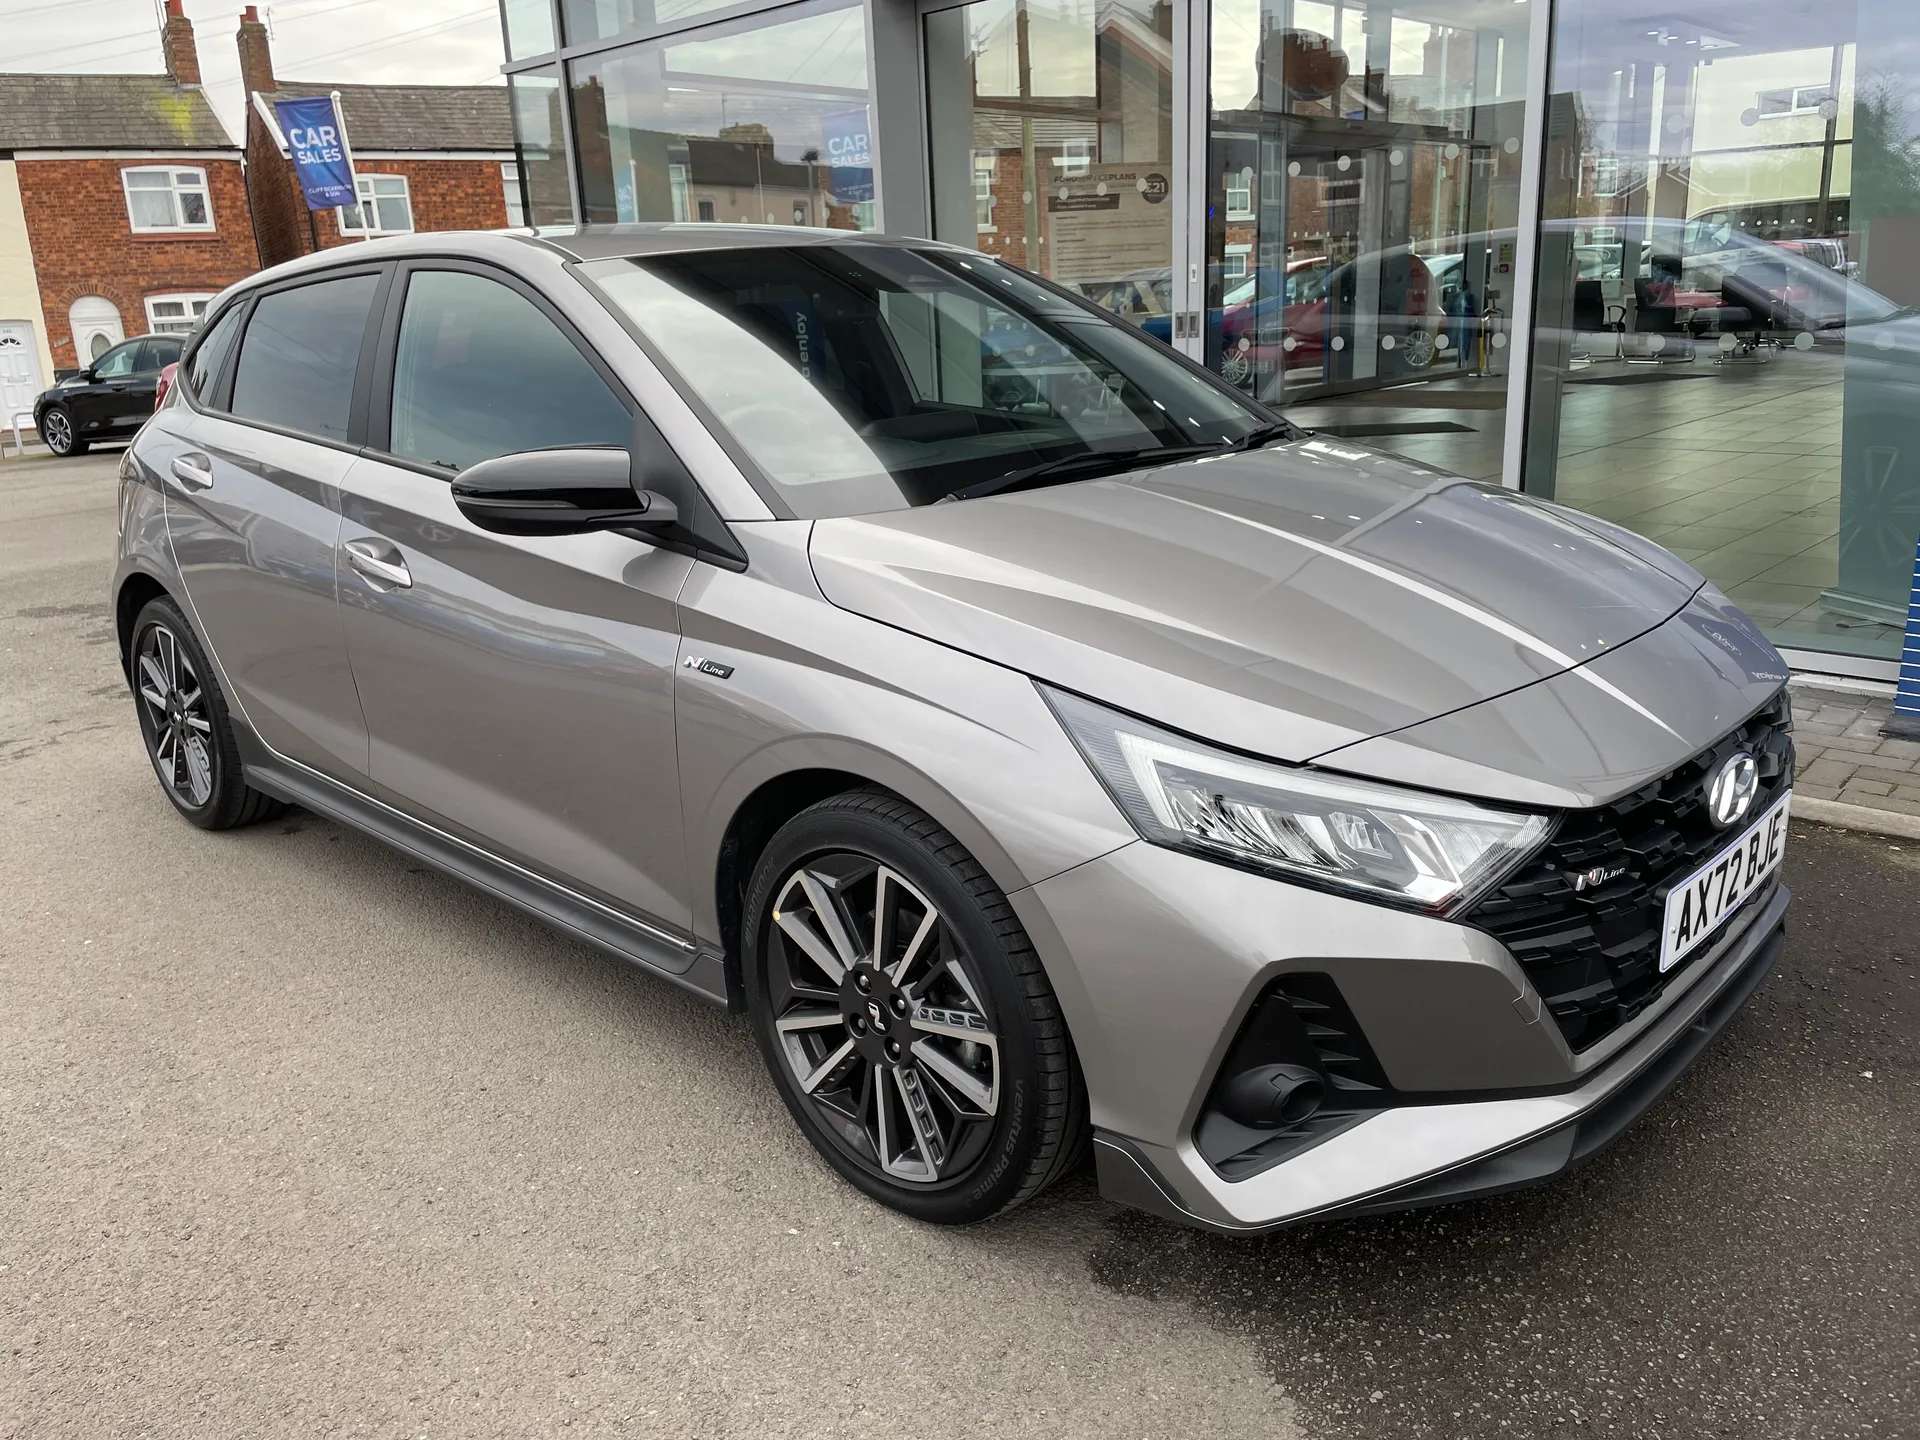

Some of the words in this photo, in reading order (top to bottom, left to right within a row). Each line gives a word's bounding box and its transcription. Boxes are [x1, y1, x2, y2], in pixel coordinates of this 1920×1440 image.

[290, 126, 337, 148] CAR
[828, 134, 868, 155] CAR
[298, 148, 341, 164] SALES
[831, 152, 870, 168] SALES
[796, 312, 808, 362] enjoy
[683, 655, 704, 668] N
[703, 664, 725, 676] Line
[1675, 847, 1743, 952] AX72
[1744, 806, 1784, 891] BJE
